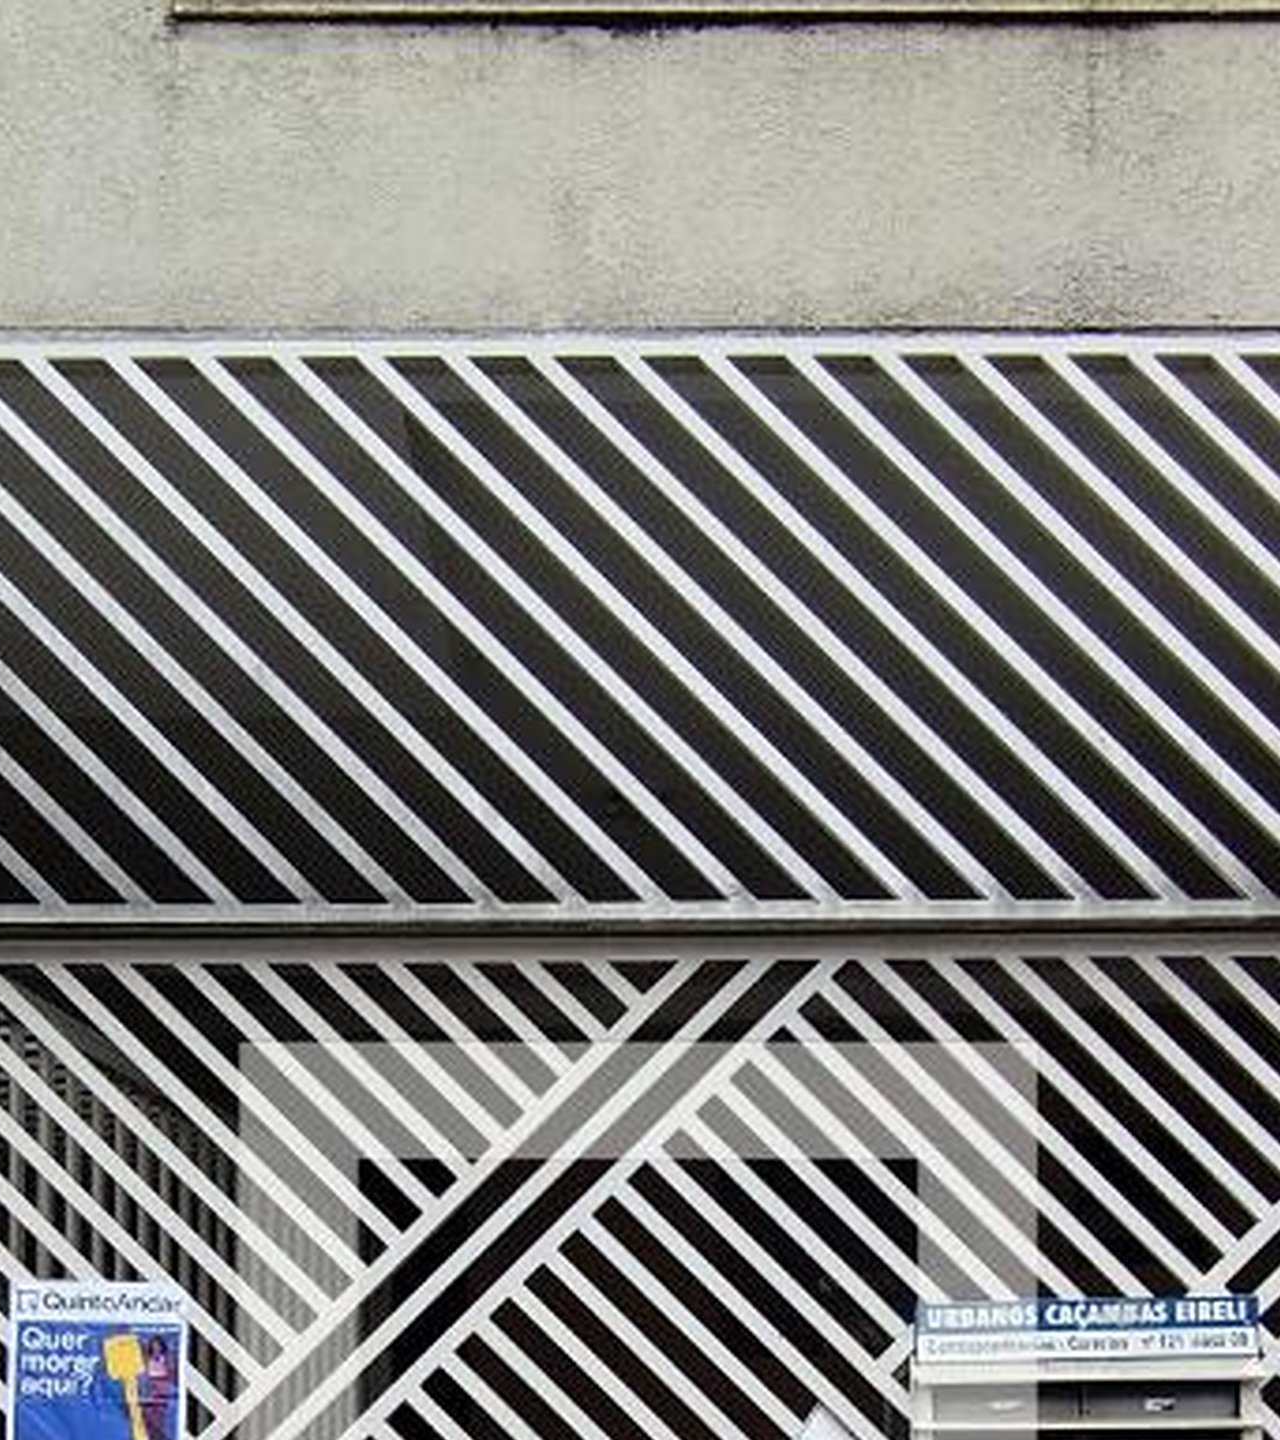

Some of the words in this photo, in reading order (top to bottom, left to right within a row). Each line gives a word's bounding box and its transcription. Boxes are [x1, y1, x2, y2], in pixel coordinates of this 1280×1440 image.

[1175, 1300, 1247, 1323] EIRELI
[21, 1326, 88, 1351] Quer
[21, 1352, 100, 1373] morar
[20, 1373, 94, 1398] aqui?
